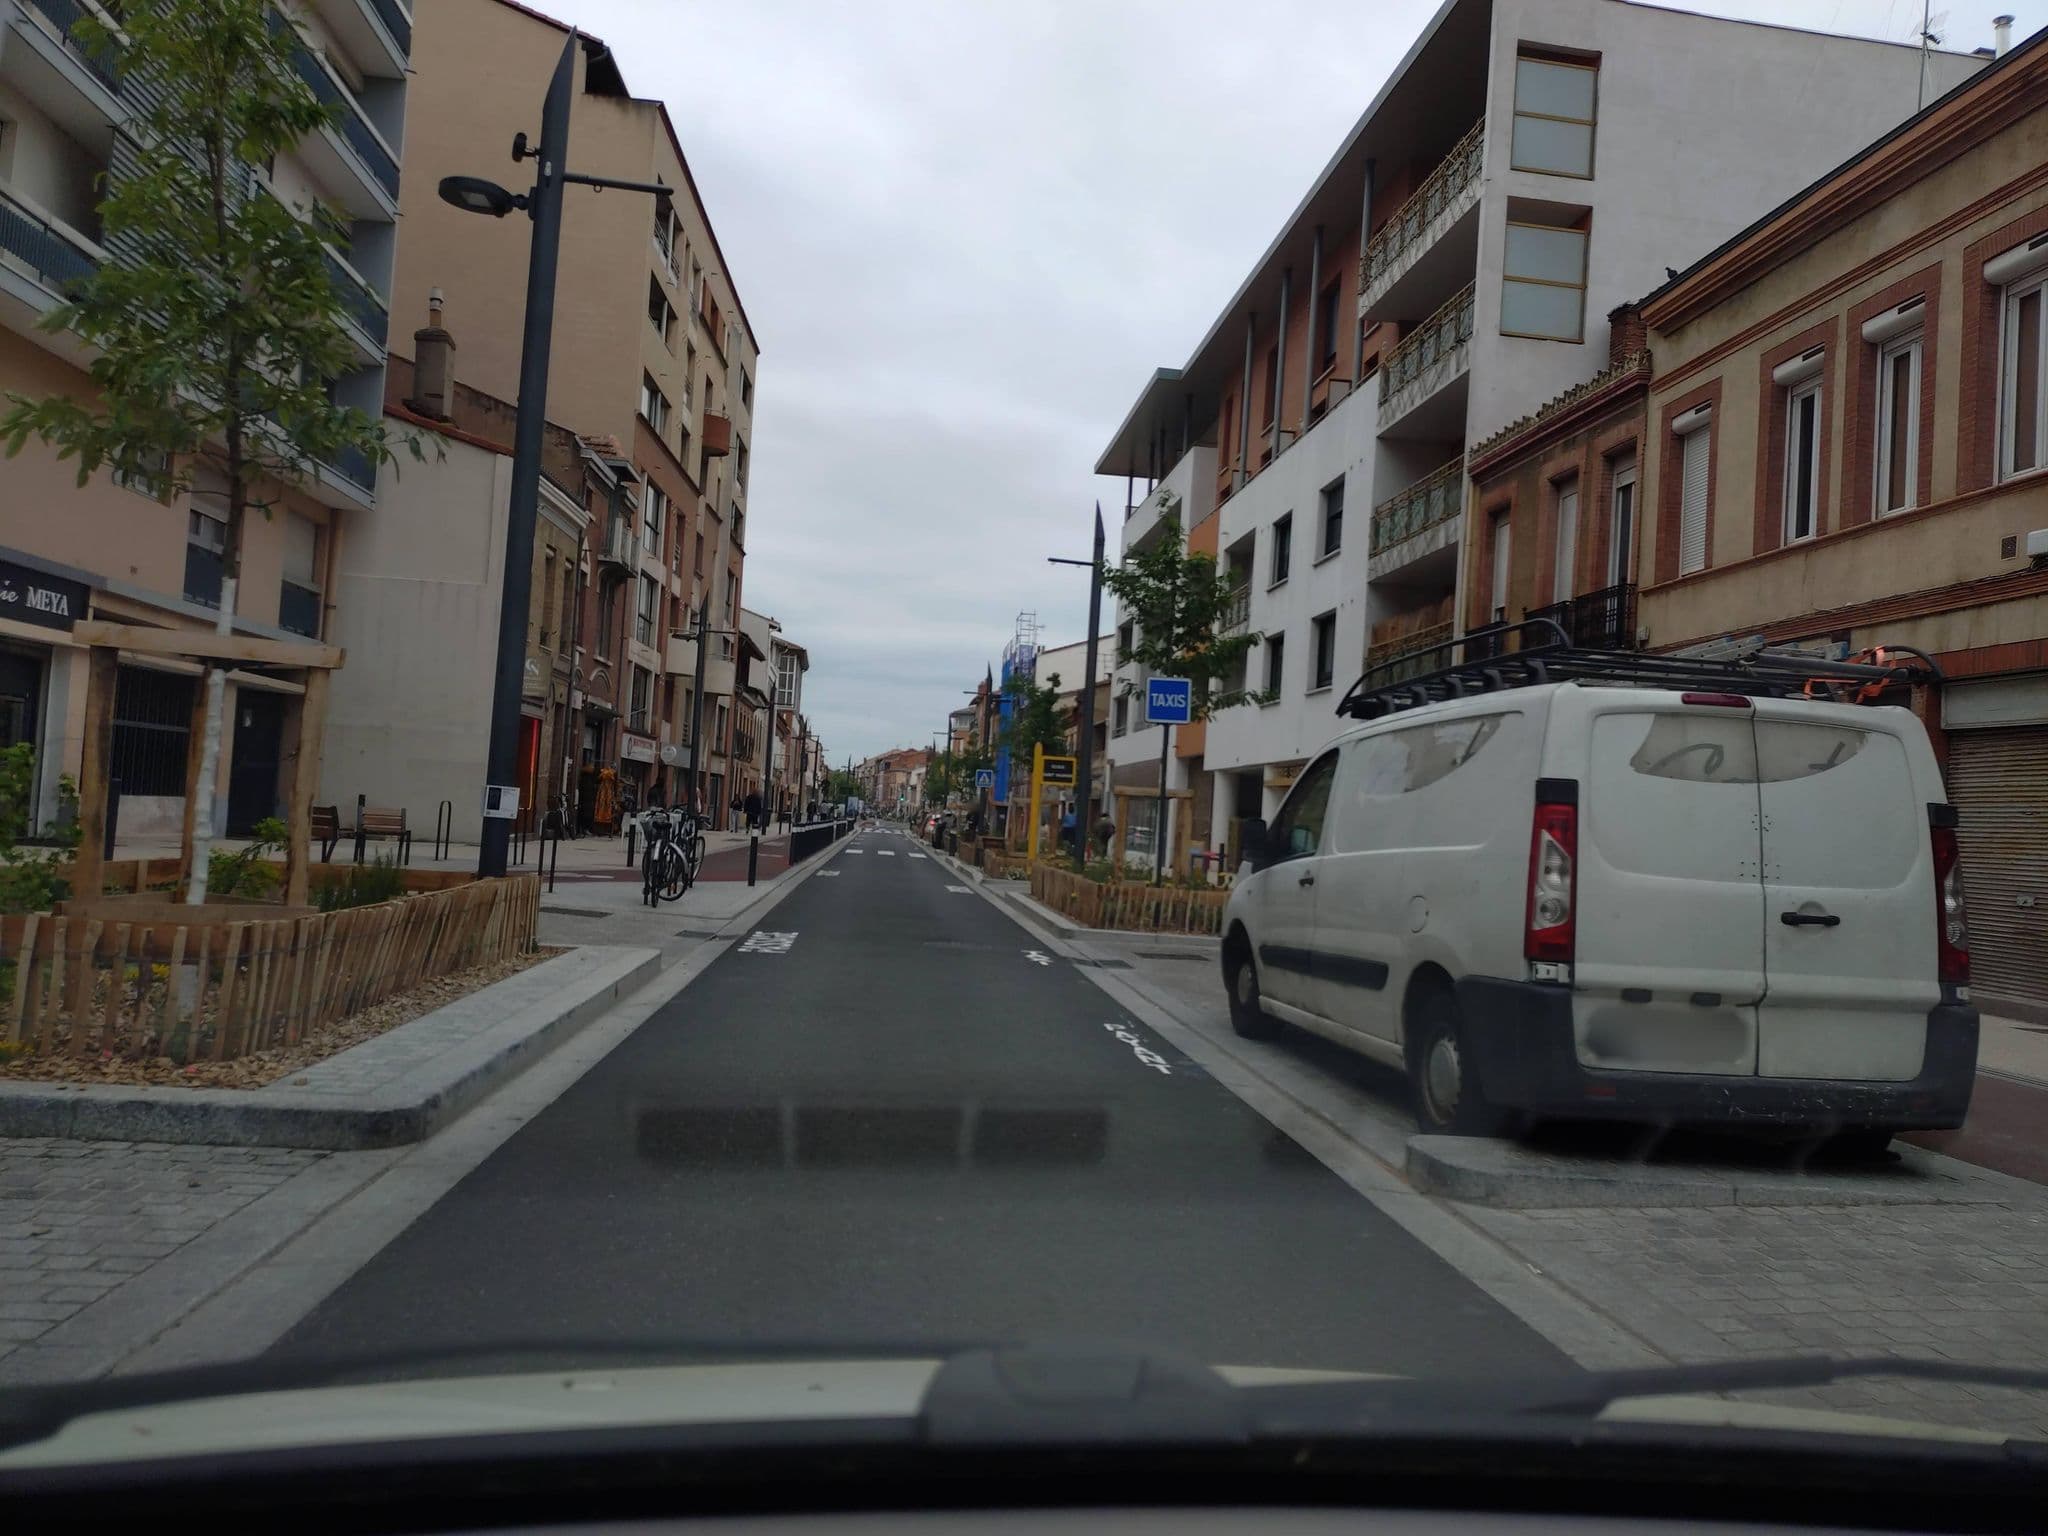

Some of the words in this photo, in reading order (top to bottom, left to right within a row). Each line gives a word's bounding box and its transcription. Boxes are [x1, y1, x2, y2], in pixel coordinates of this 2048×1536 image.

[0, 580, 19, 602] ie
[26, 586, 69, 616] MEYA
[1150, 693, 1186, 708] TAXIS
